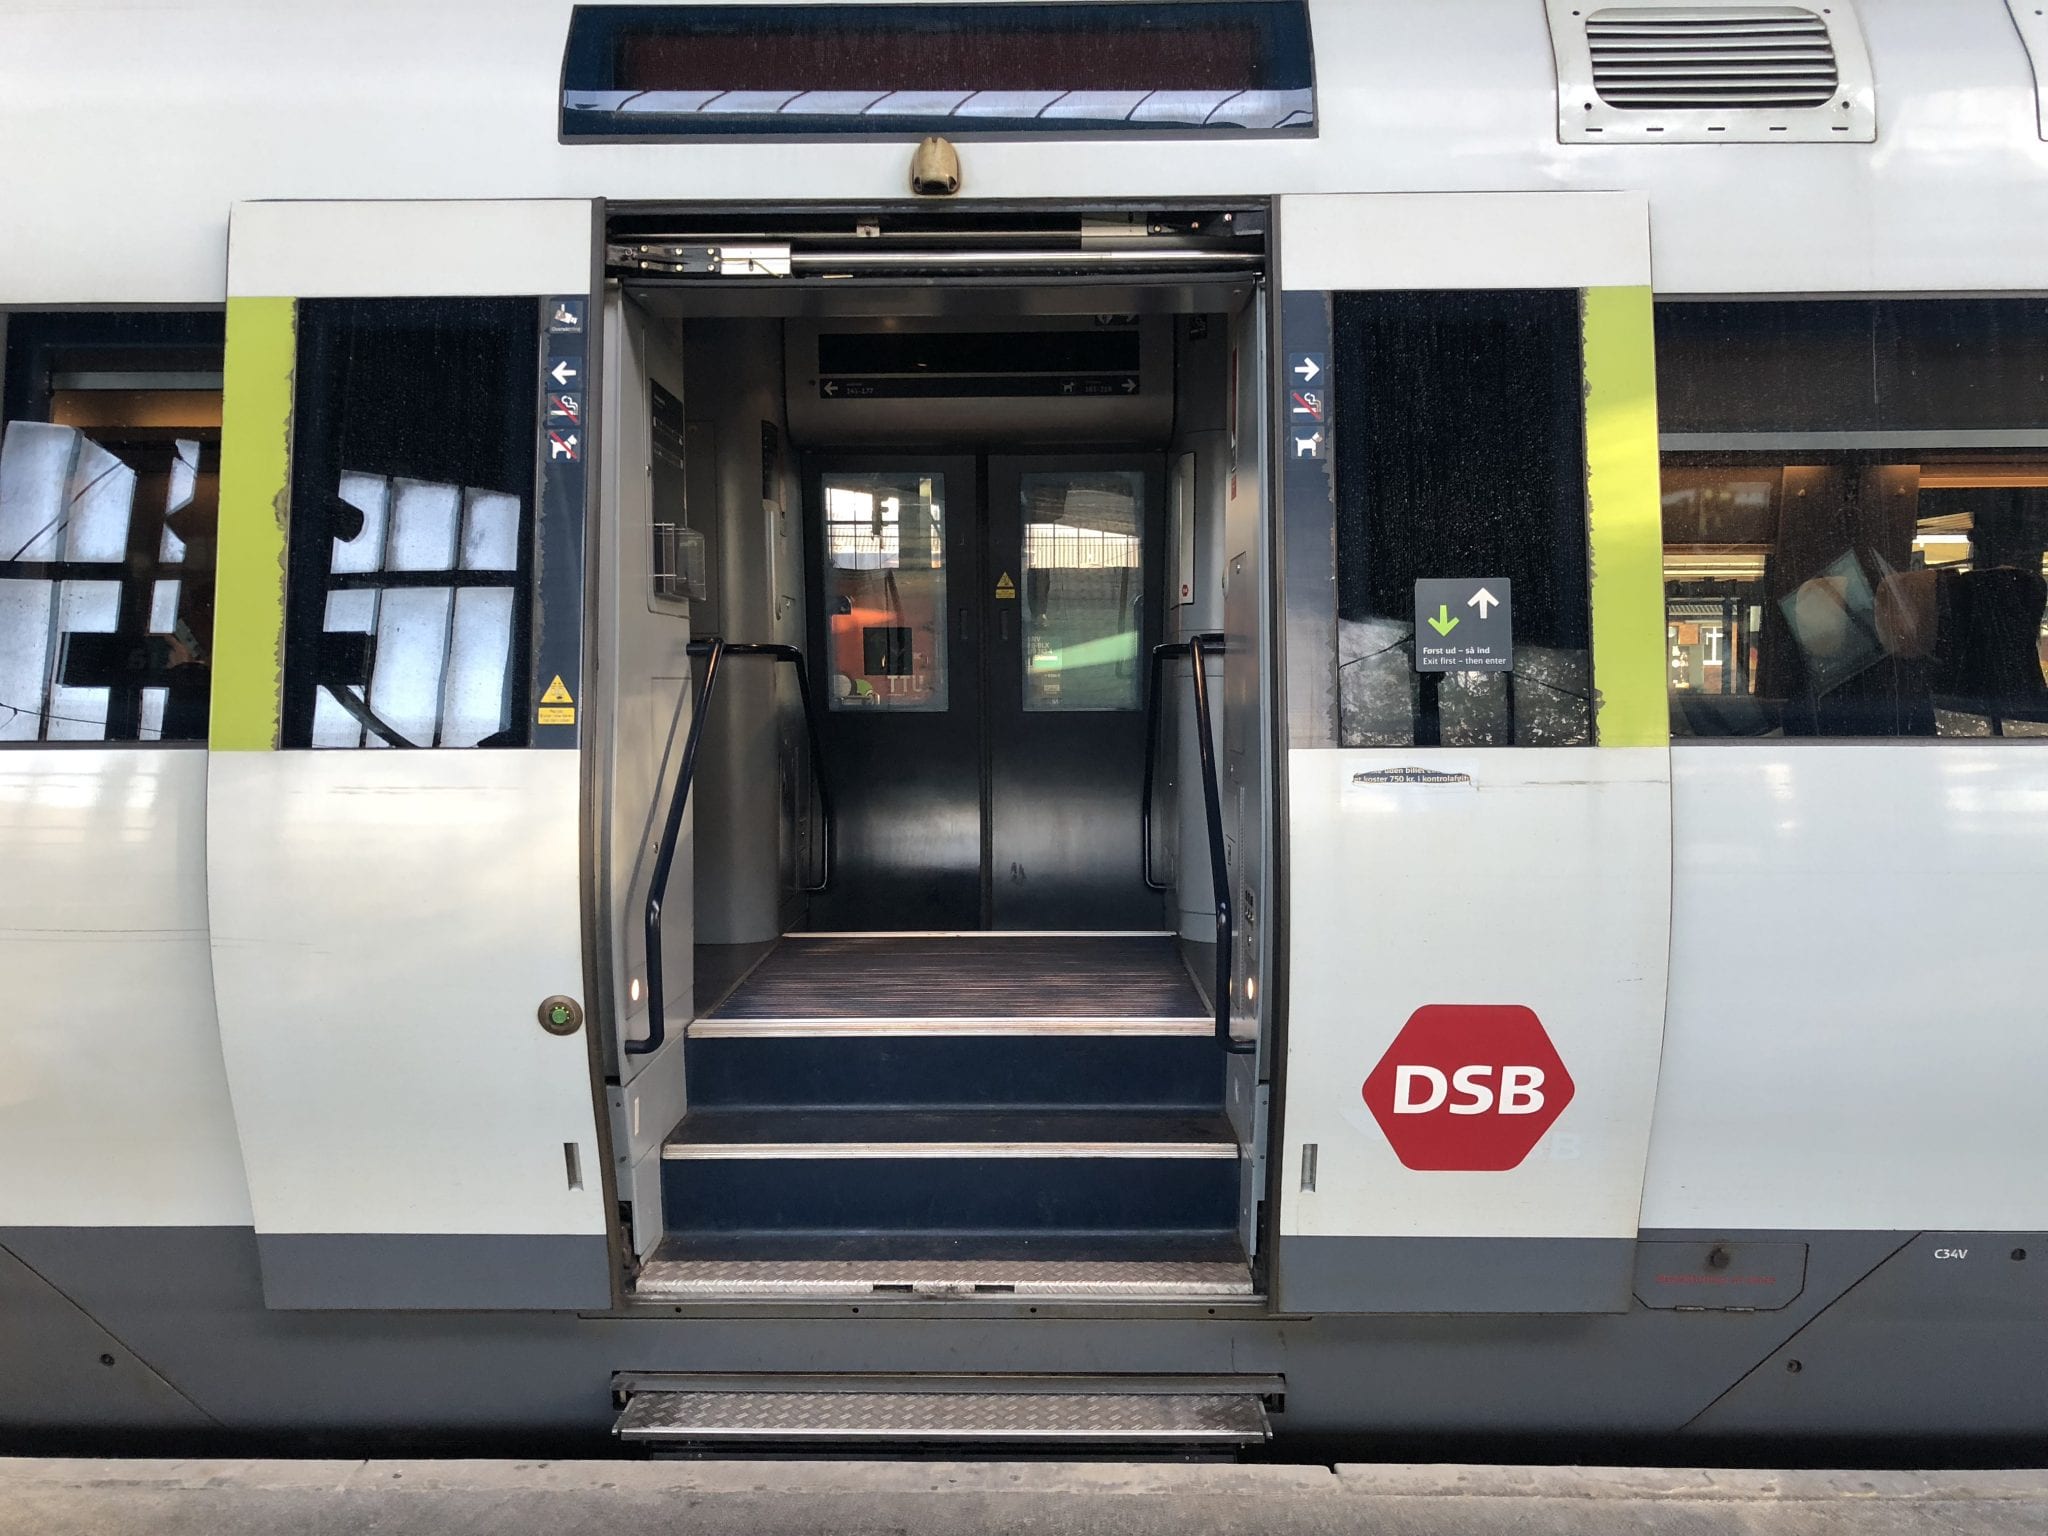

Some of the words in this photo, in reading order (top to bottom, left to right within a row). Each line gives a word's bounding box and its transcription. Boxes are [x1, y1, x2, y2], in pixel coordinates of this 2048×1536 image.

[1423, 647, 1443, 655] Først
[1445, 646, 1456, 655] ud
[1465, 646, 1475, 654] så
[1477, 646, 1490, 654] ind
[1423, 657, 1438, 665] Exit
[1440, 657, 1456, 665] first
[1465, 657, 1483, 665] then
[1389, 775, 1404, 783] 750
[1393, 1064, 1545, 1115] DSB
[1934, 1248, 1968, 1259] C34V
